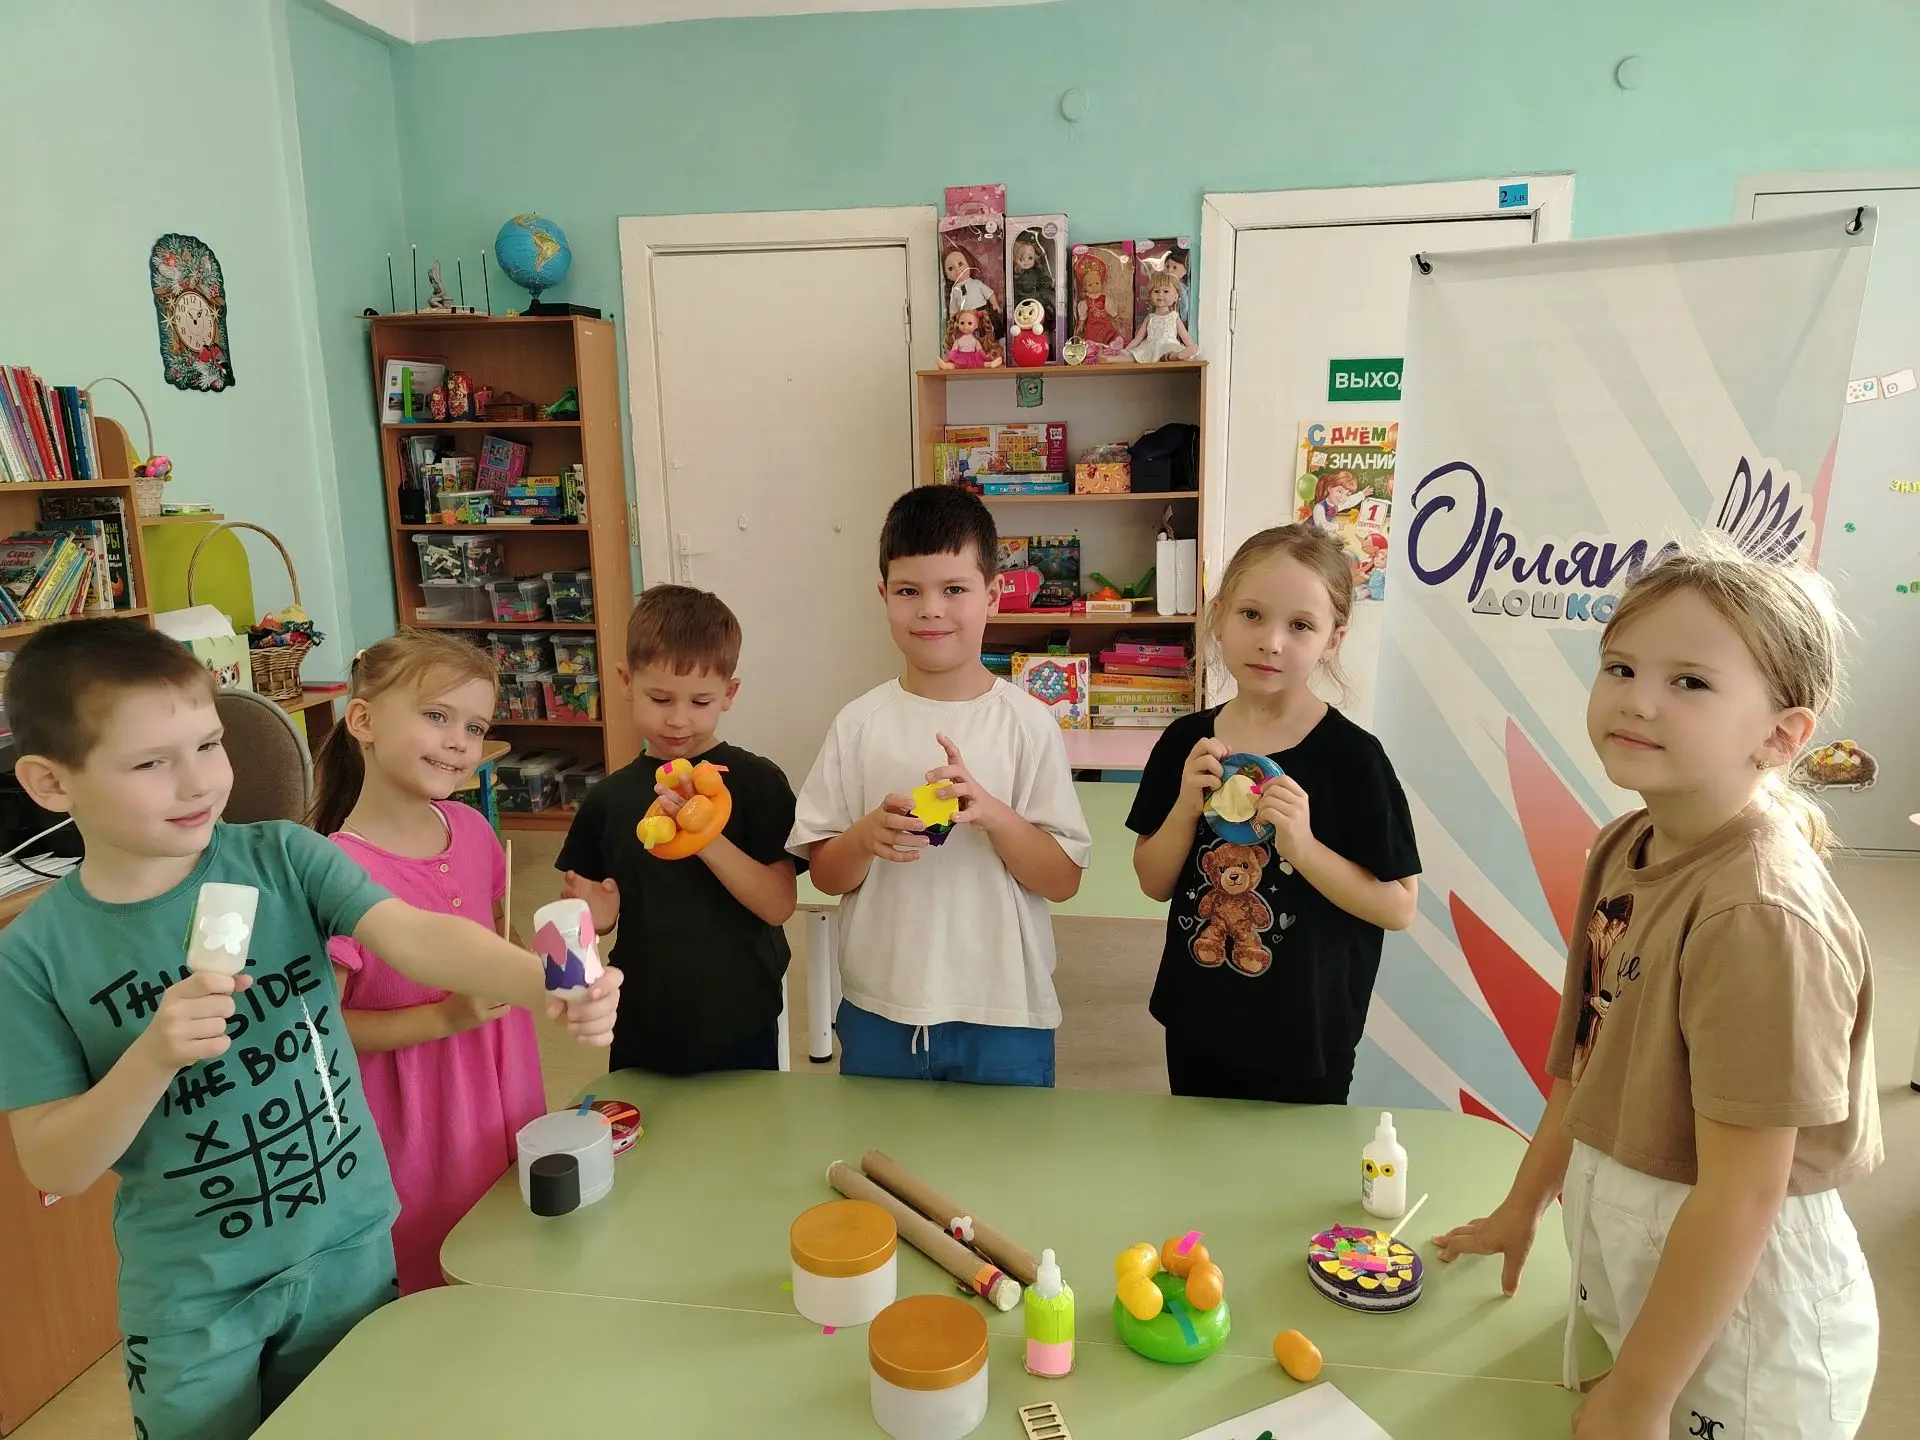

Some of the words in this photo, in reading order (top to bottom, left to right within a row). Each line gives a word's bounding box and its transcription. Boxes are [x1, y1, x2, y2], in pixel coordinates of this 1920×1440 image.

[1500, 190, 1508, 203] 2
[1335, 371, 1402, 391] ВЫХО
[1308, 424, 1326, 448] С
[1330, 426, 1387, 445] ДНЁМ
[1366, 504, 1380, 521] 1
[1472, 588, 1618, 624] ДОШКО
